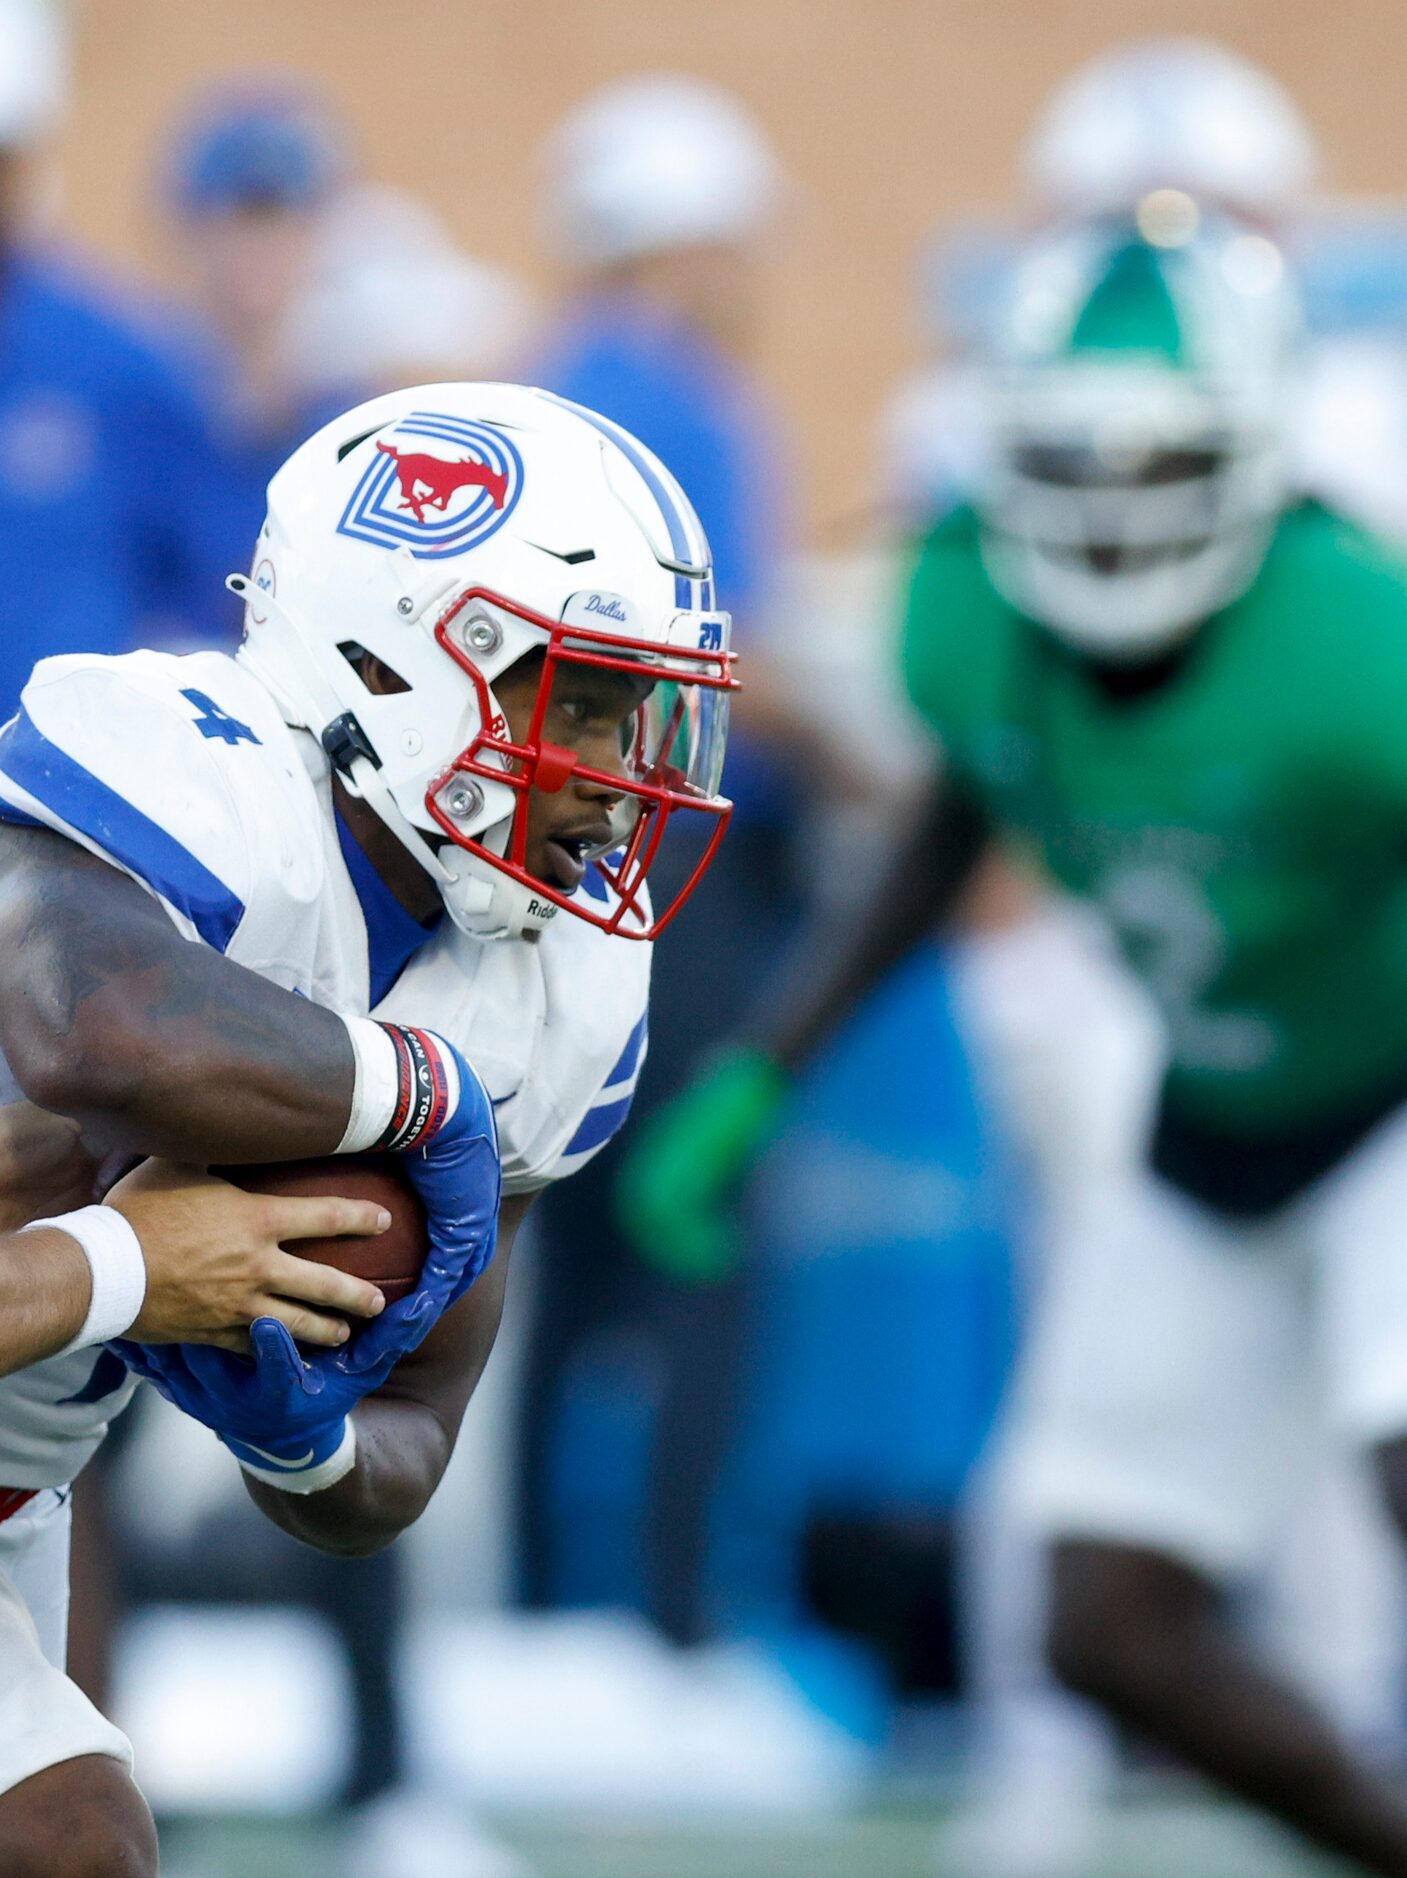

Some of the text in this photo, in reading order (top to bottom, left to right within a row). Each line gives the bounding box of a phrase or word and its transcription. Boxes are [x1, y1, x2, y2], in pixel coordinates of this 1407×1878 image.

[584, 594, 627, 622] Dallas
[178, 688, 263, 746] 4
[396, 1032, 430, 1150] CAN TOGETH
